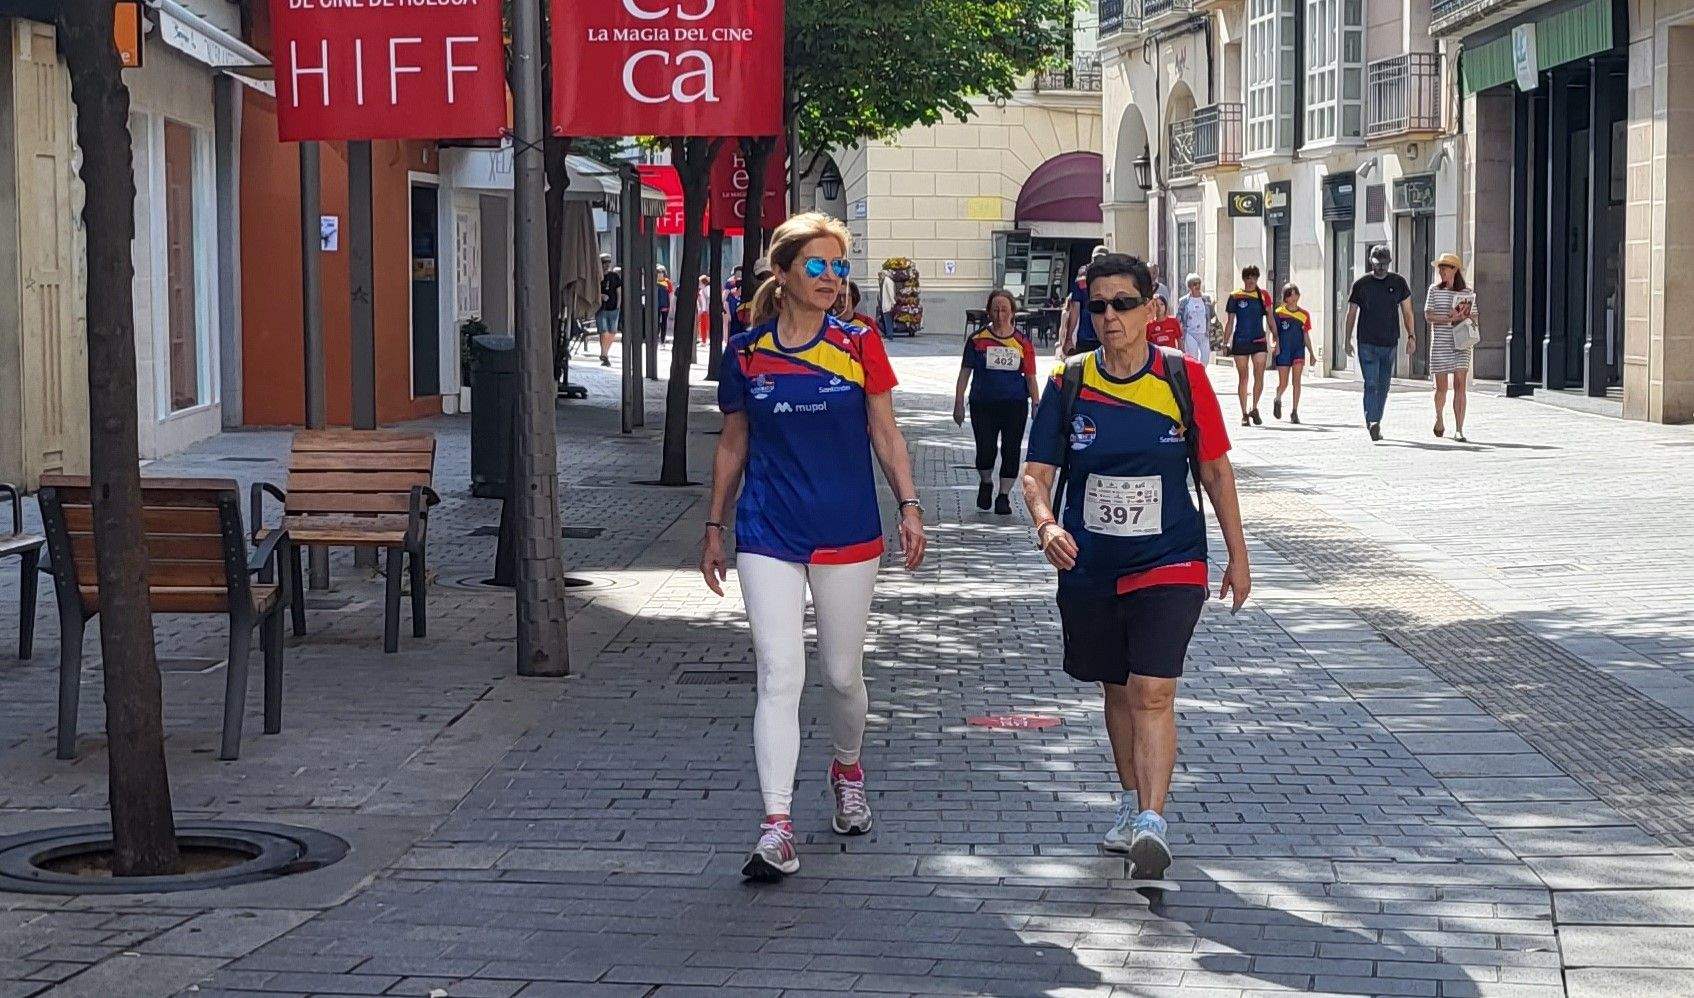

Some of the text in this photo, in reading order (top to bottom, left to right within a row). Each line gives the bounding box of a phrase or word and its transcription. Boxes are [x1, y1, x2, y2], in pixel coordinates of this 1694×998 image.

[290, 36, 479, 108] HIFF
[622, 49, 720, 104] ca
[655, 211, 685, 229] IFF
[795, 400, 828, 414] mupol
[1099, 504, 1145, 525] 397
